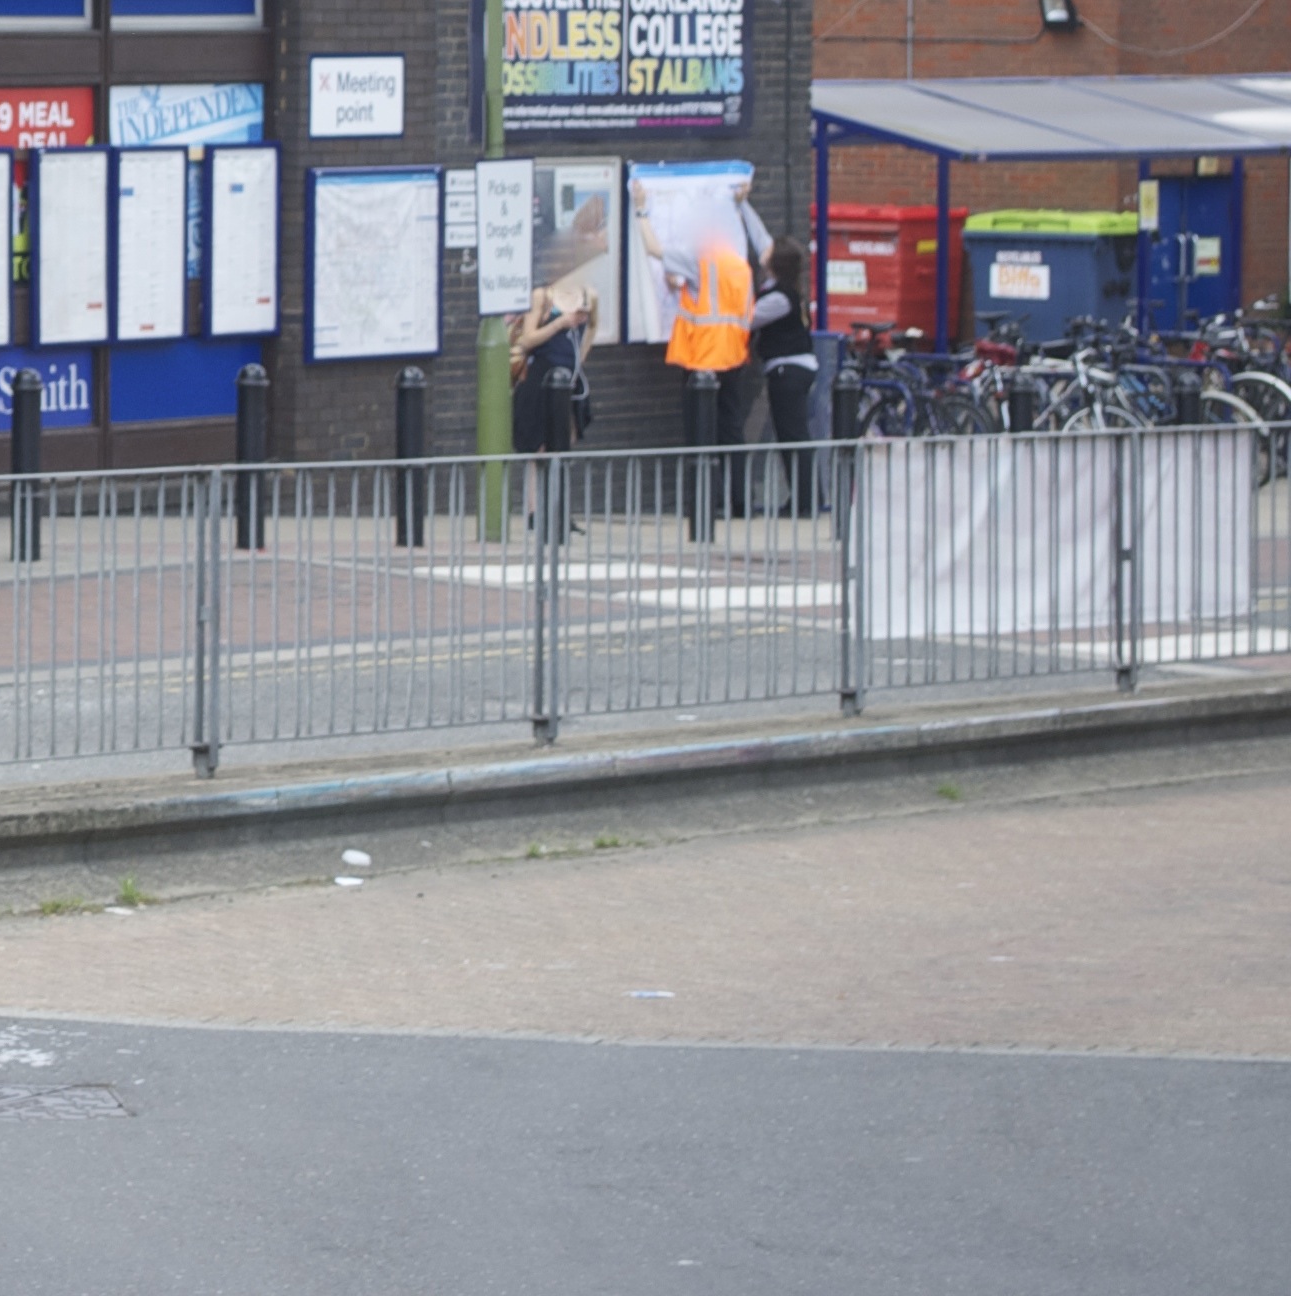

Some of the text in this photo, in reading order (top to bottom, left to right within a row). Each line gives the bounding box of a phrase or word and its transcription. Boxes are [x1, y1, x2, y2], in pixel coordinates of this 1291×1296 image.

[502, 10, 621, 60] NDLESS
[628, 14, 744, 56] COLLEGE
[336, 71, 396, 98] Meeting
[502, 61, 619, 95] OSSIBILITIES
[628, 58, 744, 94] ST ALBANS
[18, 100, 75, 128] MEAL
[336, 101, 374, 129] point
[18, 131, 67, 149] DEAL
